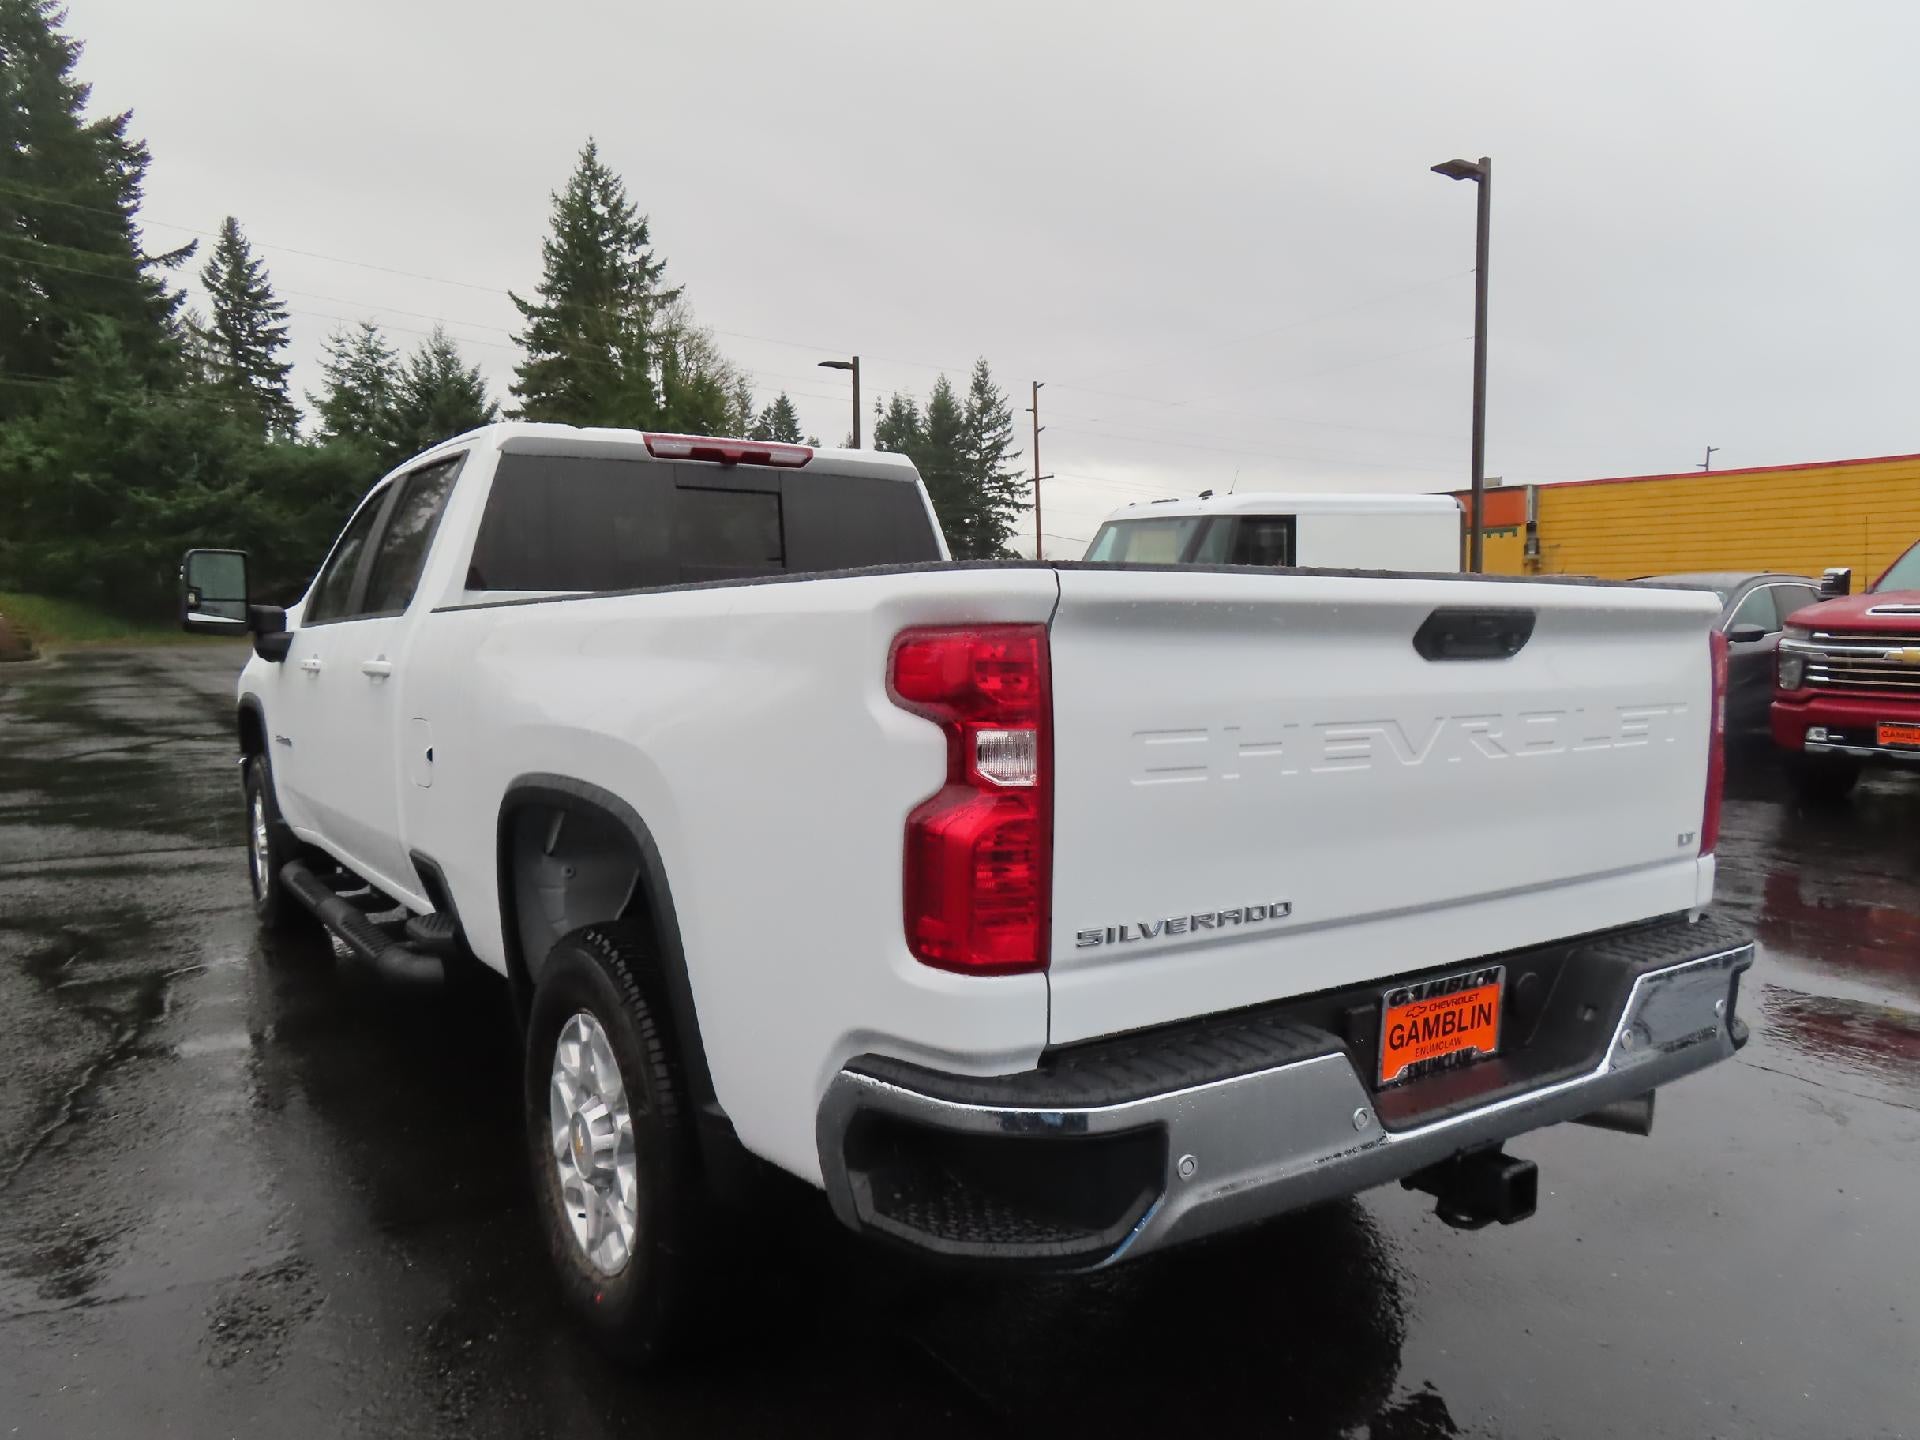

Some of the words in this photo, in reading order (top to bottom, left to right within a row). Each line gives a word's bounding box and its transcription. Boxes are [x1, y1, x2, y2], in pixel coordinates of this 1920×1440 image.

[1131, 702, 1687, 785] CHEVROLET
[1076, 901, 1293, 948] SILVERADO
[1428, 993, 1478, 1010] CHEVROLET
[1389, 1002, 1491, 1050] GAMBLIN
